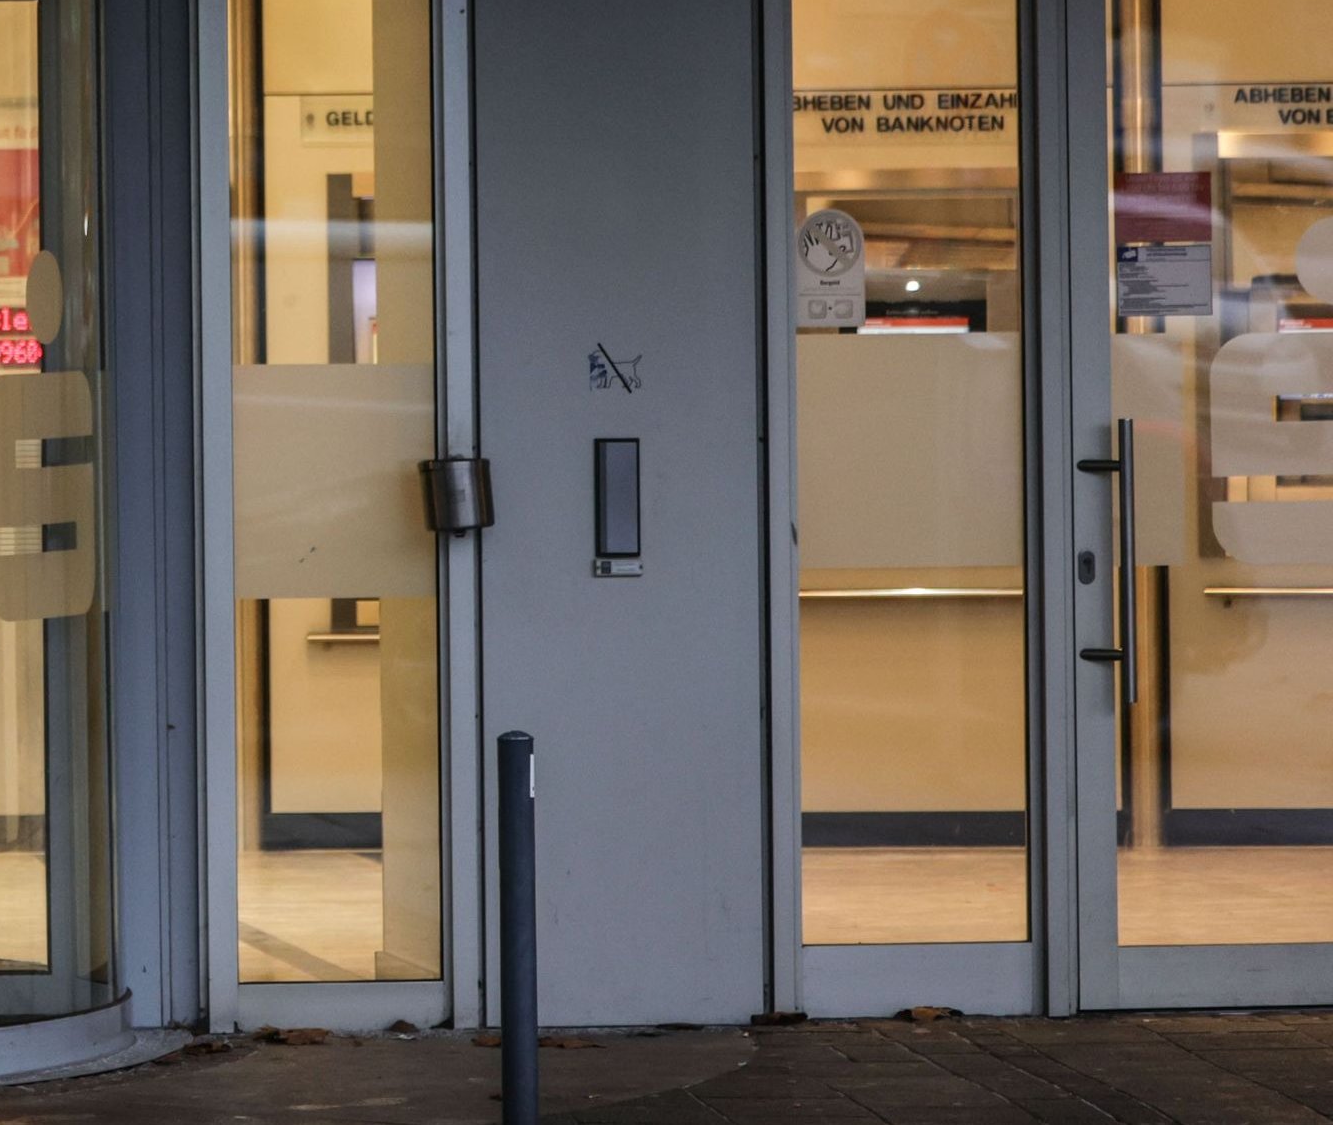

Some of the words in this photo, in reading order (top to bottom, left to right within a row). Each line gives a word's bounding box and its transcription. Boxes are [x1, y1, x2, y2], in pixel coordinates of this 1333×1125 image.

[883, 94, 925, 111] UND
[1234, 87, 1331, 104] ABHEBEN
[821, 117, 864, 133] VON
[876, 115, 1005, 133] BANKNOTEN
[1278, 108, 1321, 125] VON
